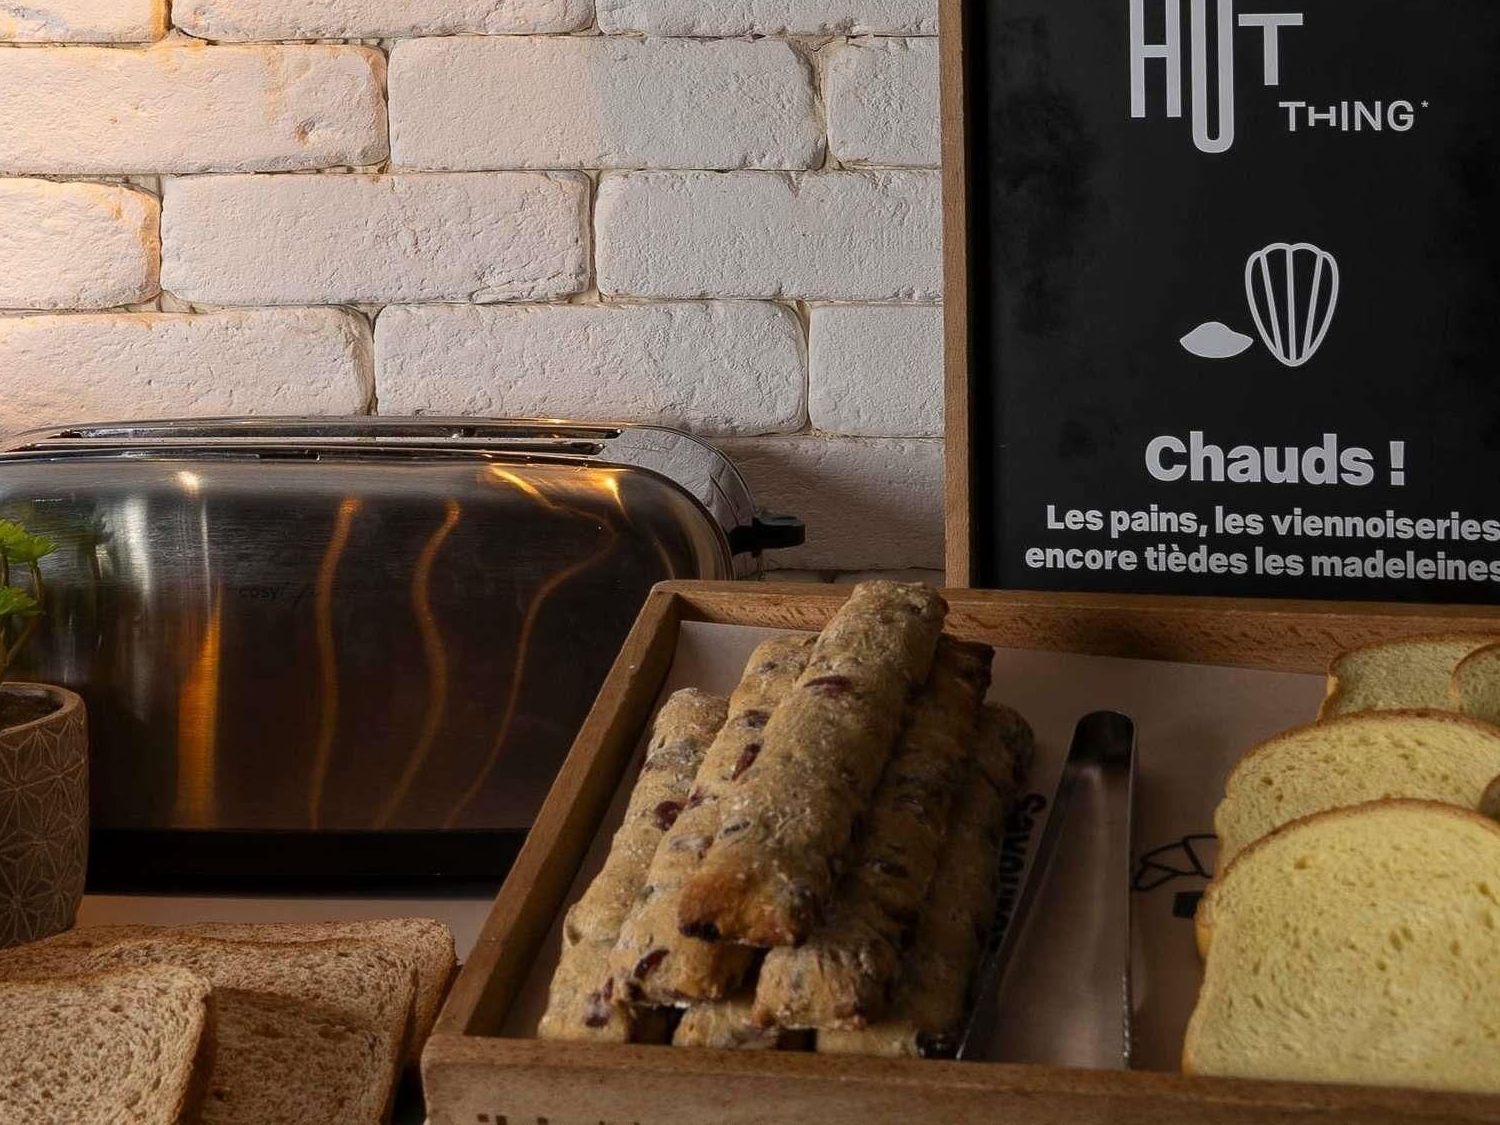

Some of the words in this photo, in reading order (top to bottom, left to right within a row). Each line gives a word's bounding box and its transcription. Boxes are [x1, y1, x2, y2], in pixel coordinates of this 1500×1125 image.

[1145, 431, 1374, 485] Chauds
[1389, 440, 1405, 486] !
[1046, 504, 1103, 531] Les
[1110, 504, 1208, 538] pains,
[1215, 505, 1264, 535] les
[1271, 508, 1500, 542] viennoiseries
[1024, 547, 1137, 571] encore
[1145, 543, 1248, 574] tièdes
[1254, 546, 1304, 576] les
[1311, 549, 1500, 582] madeleines
